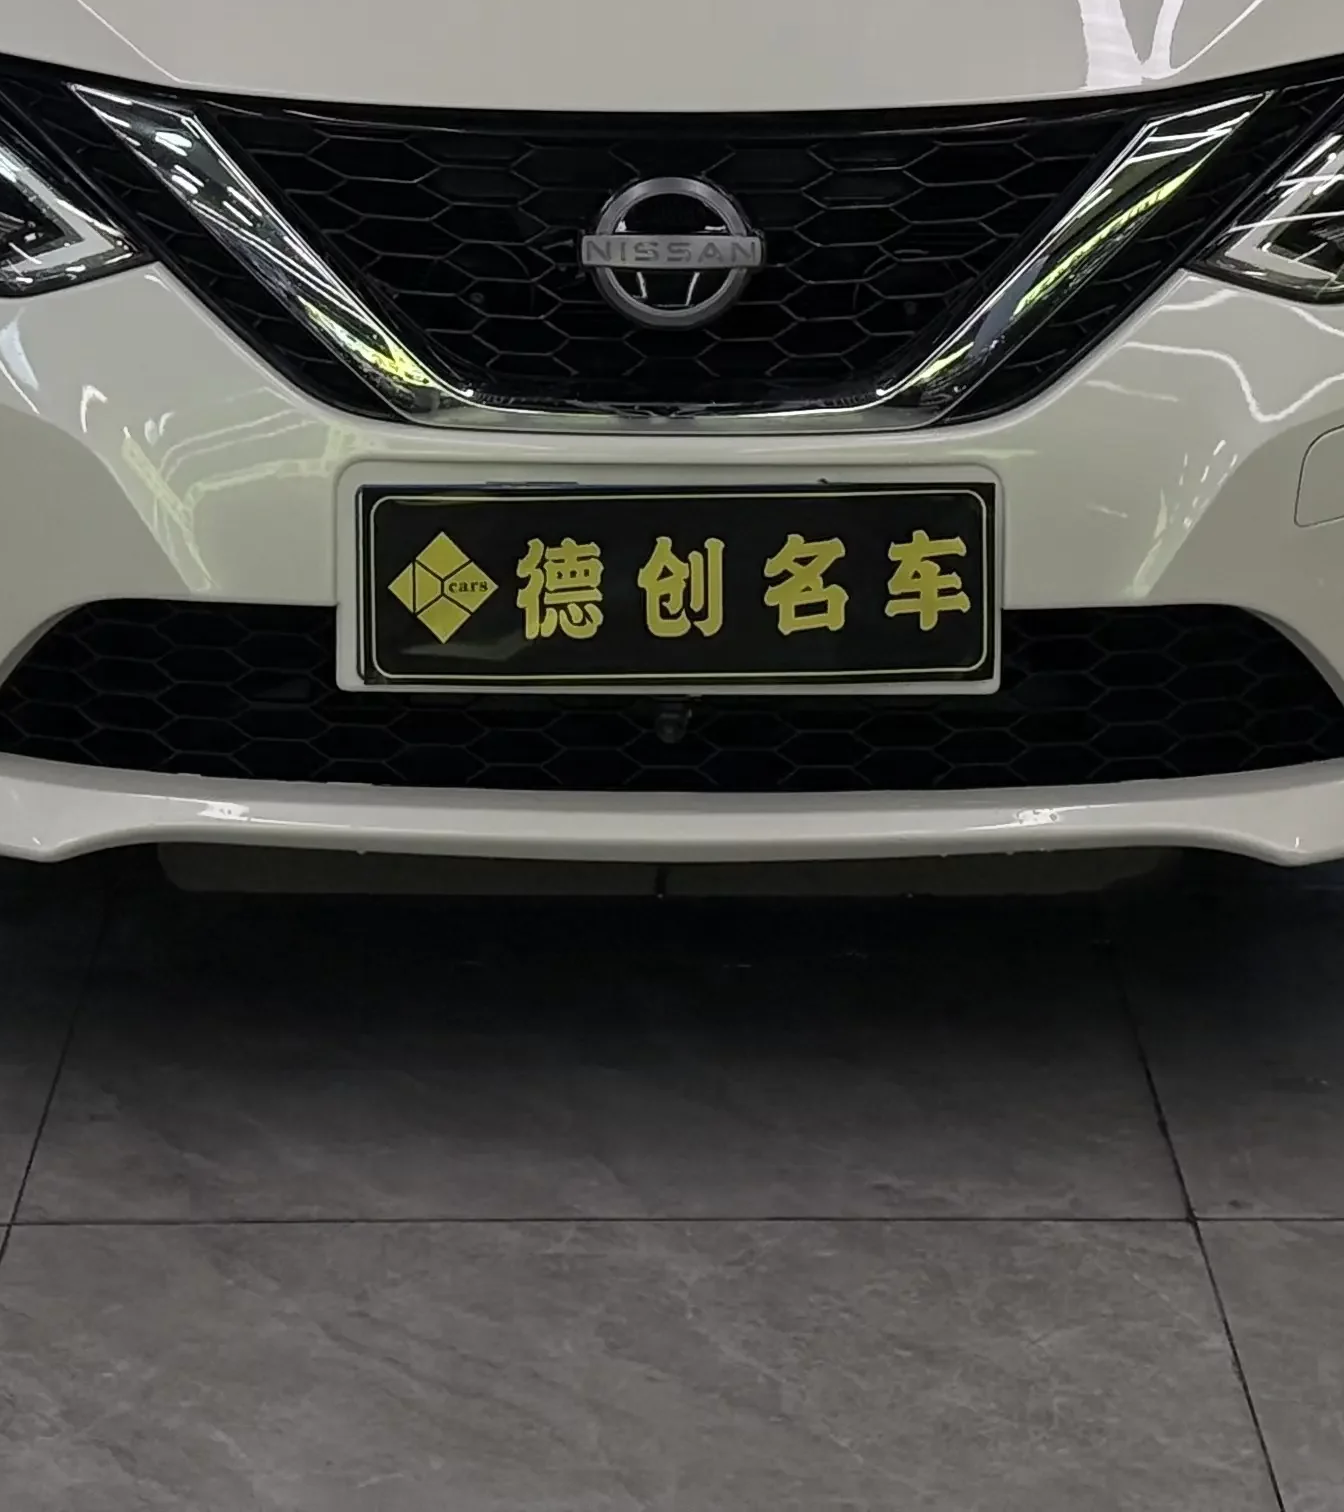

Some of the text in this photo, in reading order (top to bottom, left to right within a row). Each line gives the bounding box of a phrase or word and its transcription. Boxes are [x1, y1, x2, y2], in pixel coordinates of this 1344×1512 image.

[585, 238, 757, 263] NISSAN
[448, 580, 489, 594] cars
[517, 530, 971, 640] 德创名车
